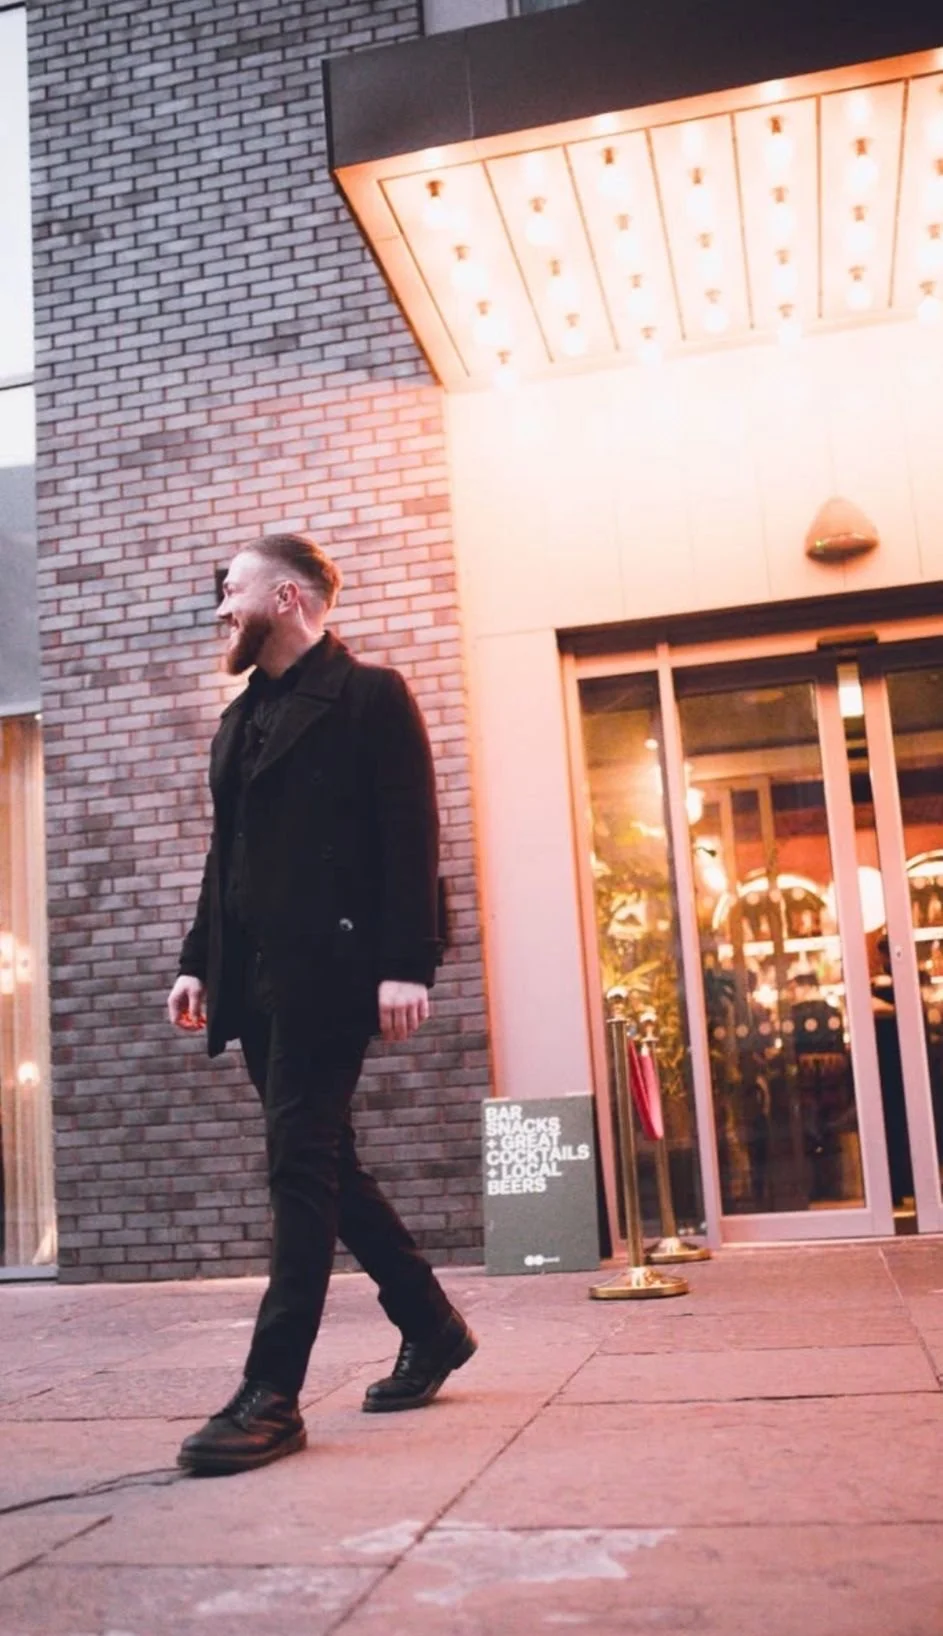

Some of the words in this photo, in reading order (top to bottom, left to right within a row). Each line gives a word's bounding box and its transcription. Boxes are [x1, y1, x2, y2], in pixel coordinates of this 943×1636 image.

[485, 1105, 522, 1121] BAR
[485, 1116, 561, 1136] SNACKS
[500, 1132, 562, 1150] GREAT
[486, 1144, 590, 1165] COCKTAILS
[501, 1161, 563, 1180] LOCAL
[487, 1177, 547, 1196] BEERS
